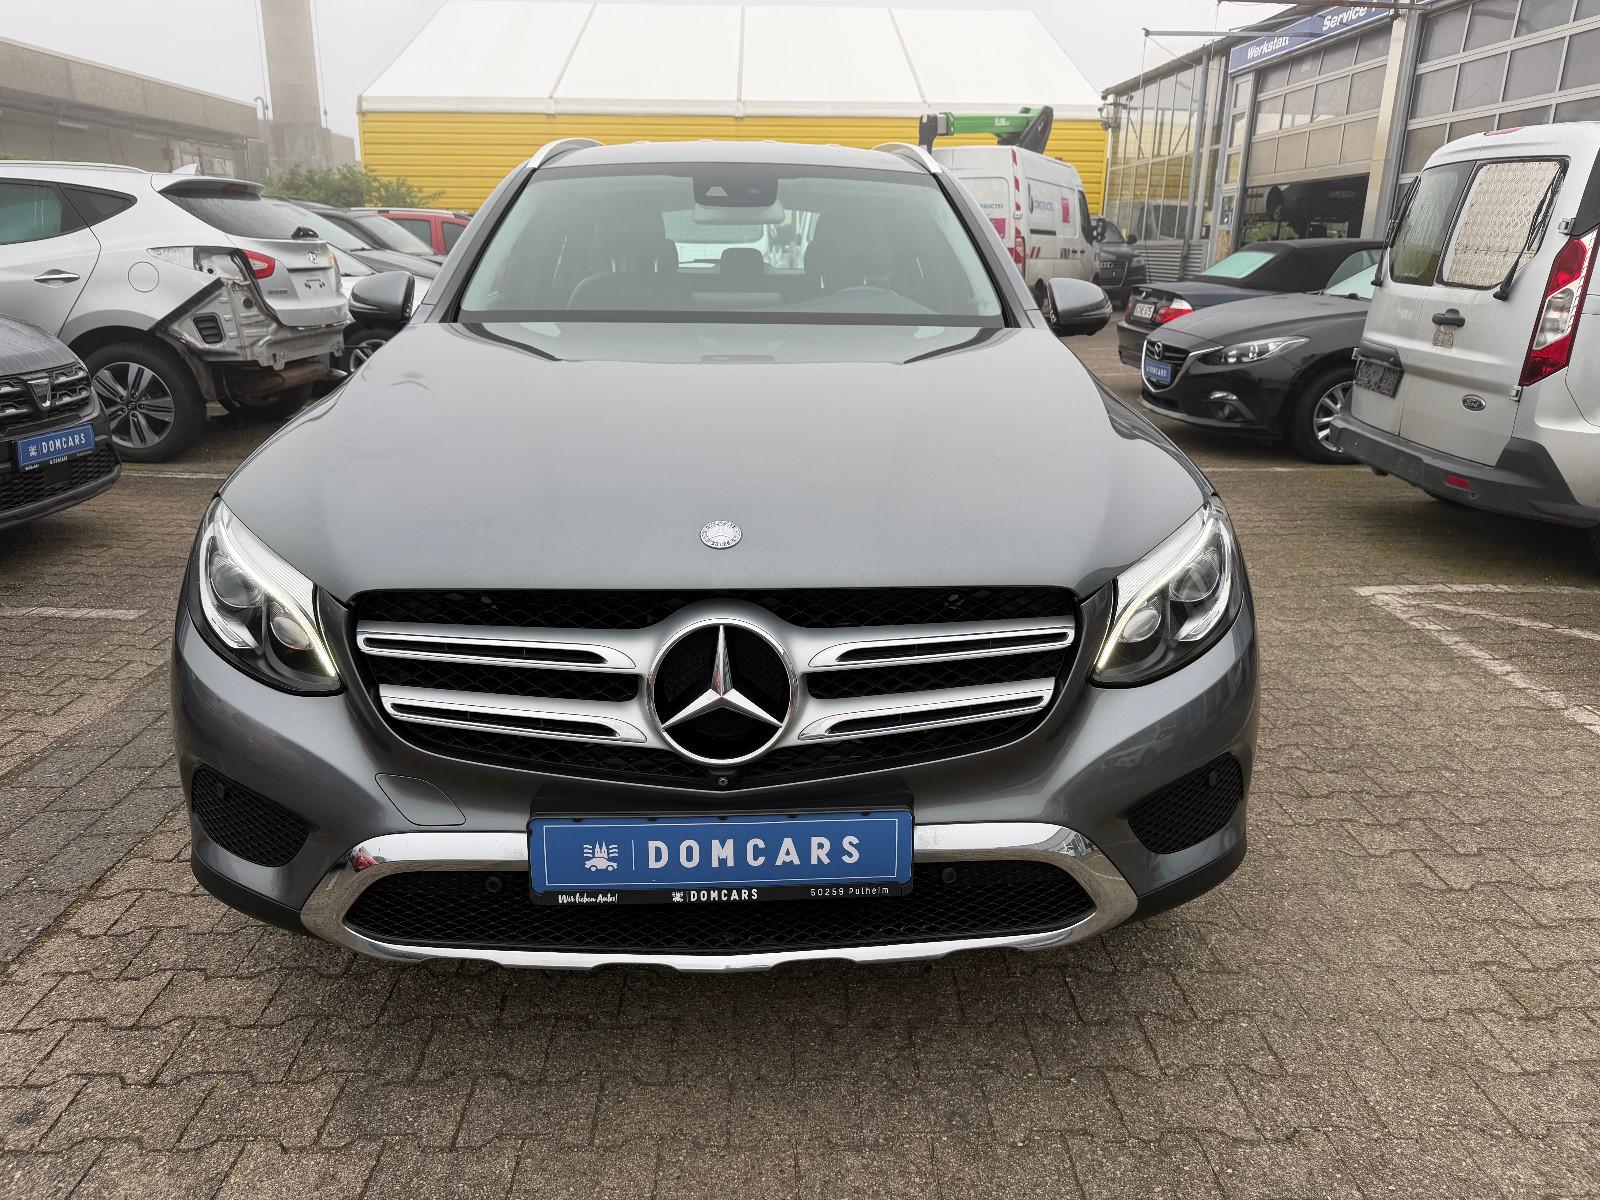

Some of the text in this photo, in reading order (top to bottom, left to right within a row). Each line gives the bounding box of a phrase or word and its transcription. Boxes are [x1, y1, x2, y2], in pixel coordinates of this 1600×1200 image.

[1322, 7, 1368, 31] Service
[42, 433, 86, 454] DOMCARS
[648, 835, 860, 869] DOMCARS
[690, 888, 758, 902] DOMCARS
[810, 886, 889, 897] 50259 Pulheim
